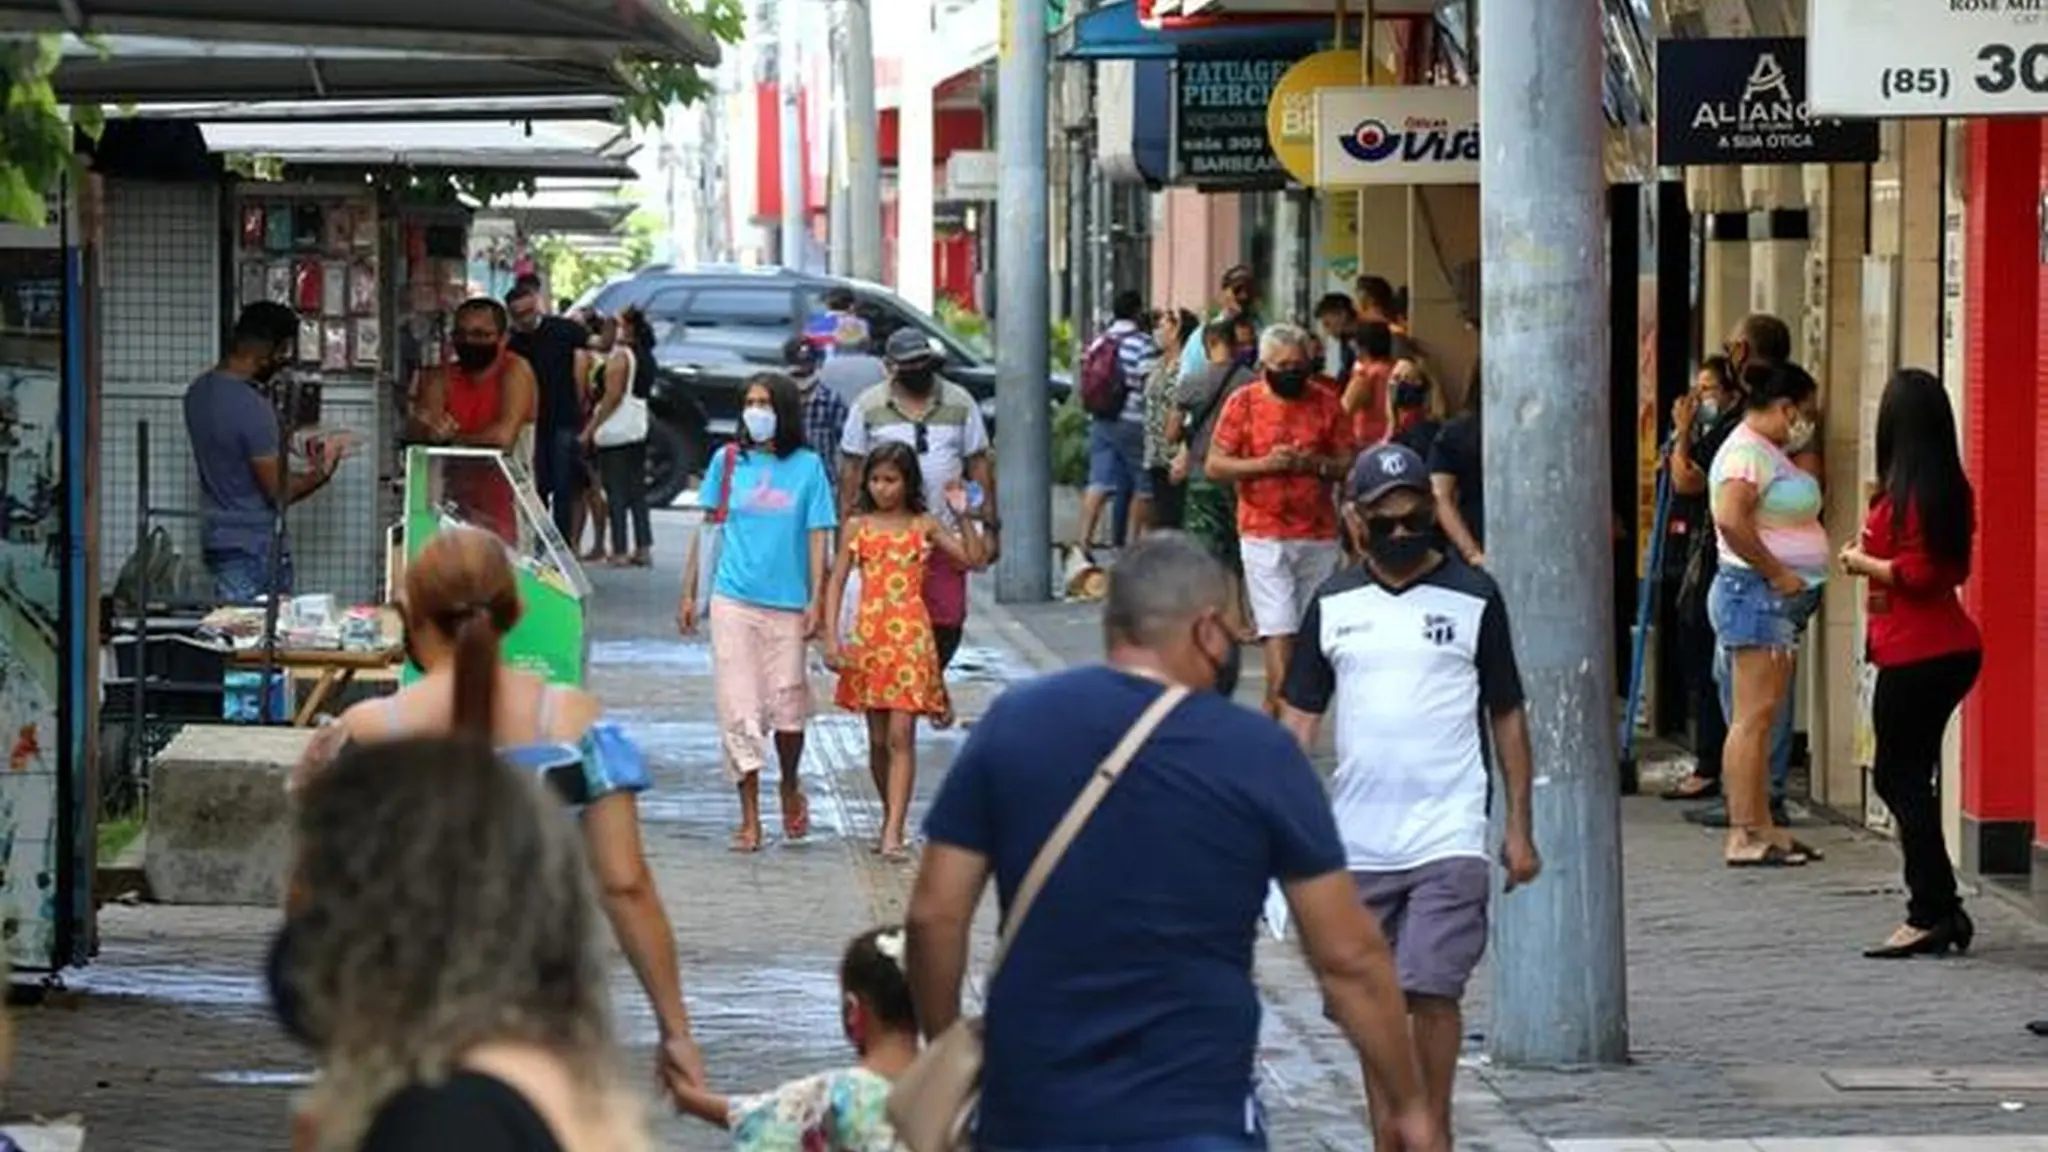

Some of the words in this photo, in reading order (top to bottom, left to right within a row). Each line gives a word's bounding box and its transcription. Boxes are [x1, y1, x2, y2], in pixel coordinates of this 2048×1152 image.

[1882, 67, 1950, 99] (85)
[1691, 101, 1842, 129] ALIANÇ
[1717, 136, 1729, 148] A
[1732, 134, 1763, 148] SUA
